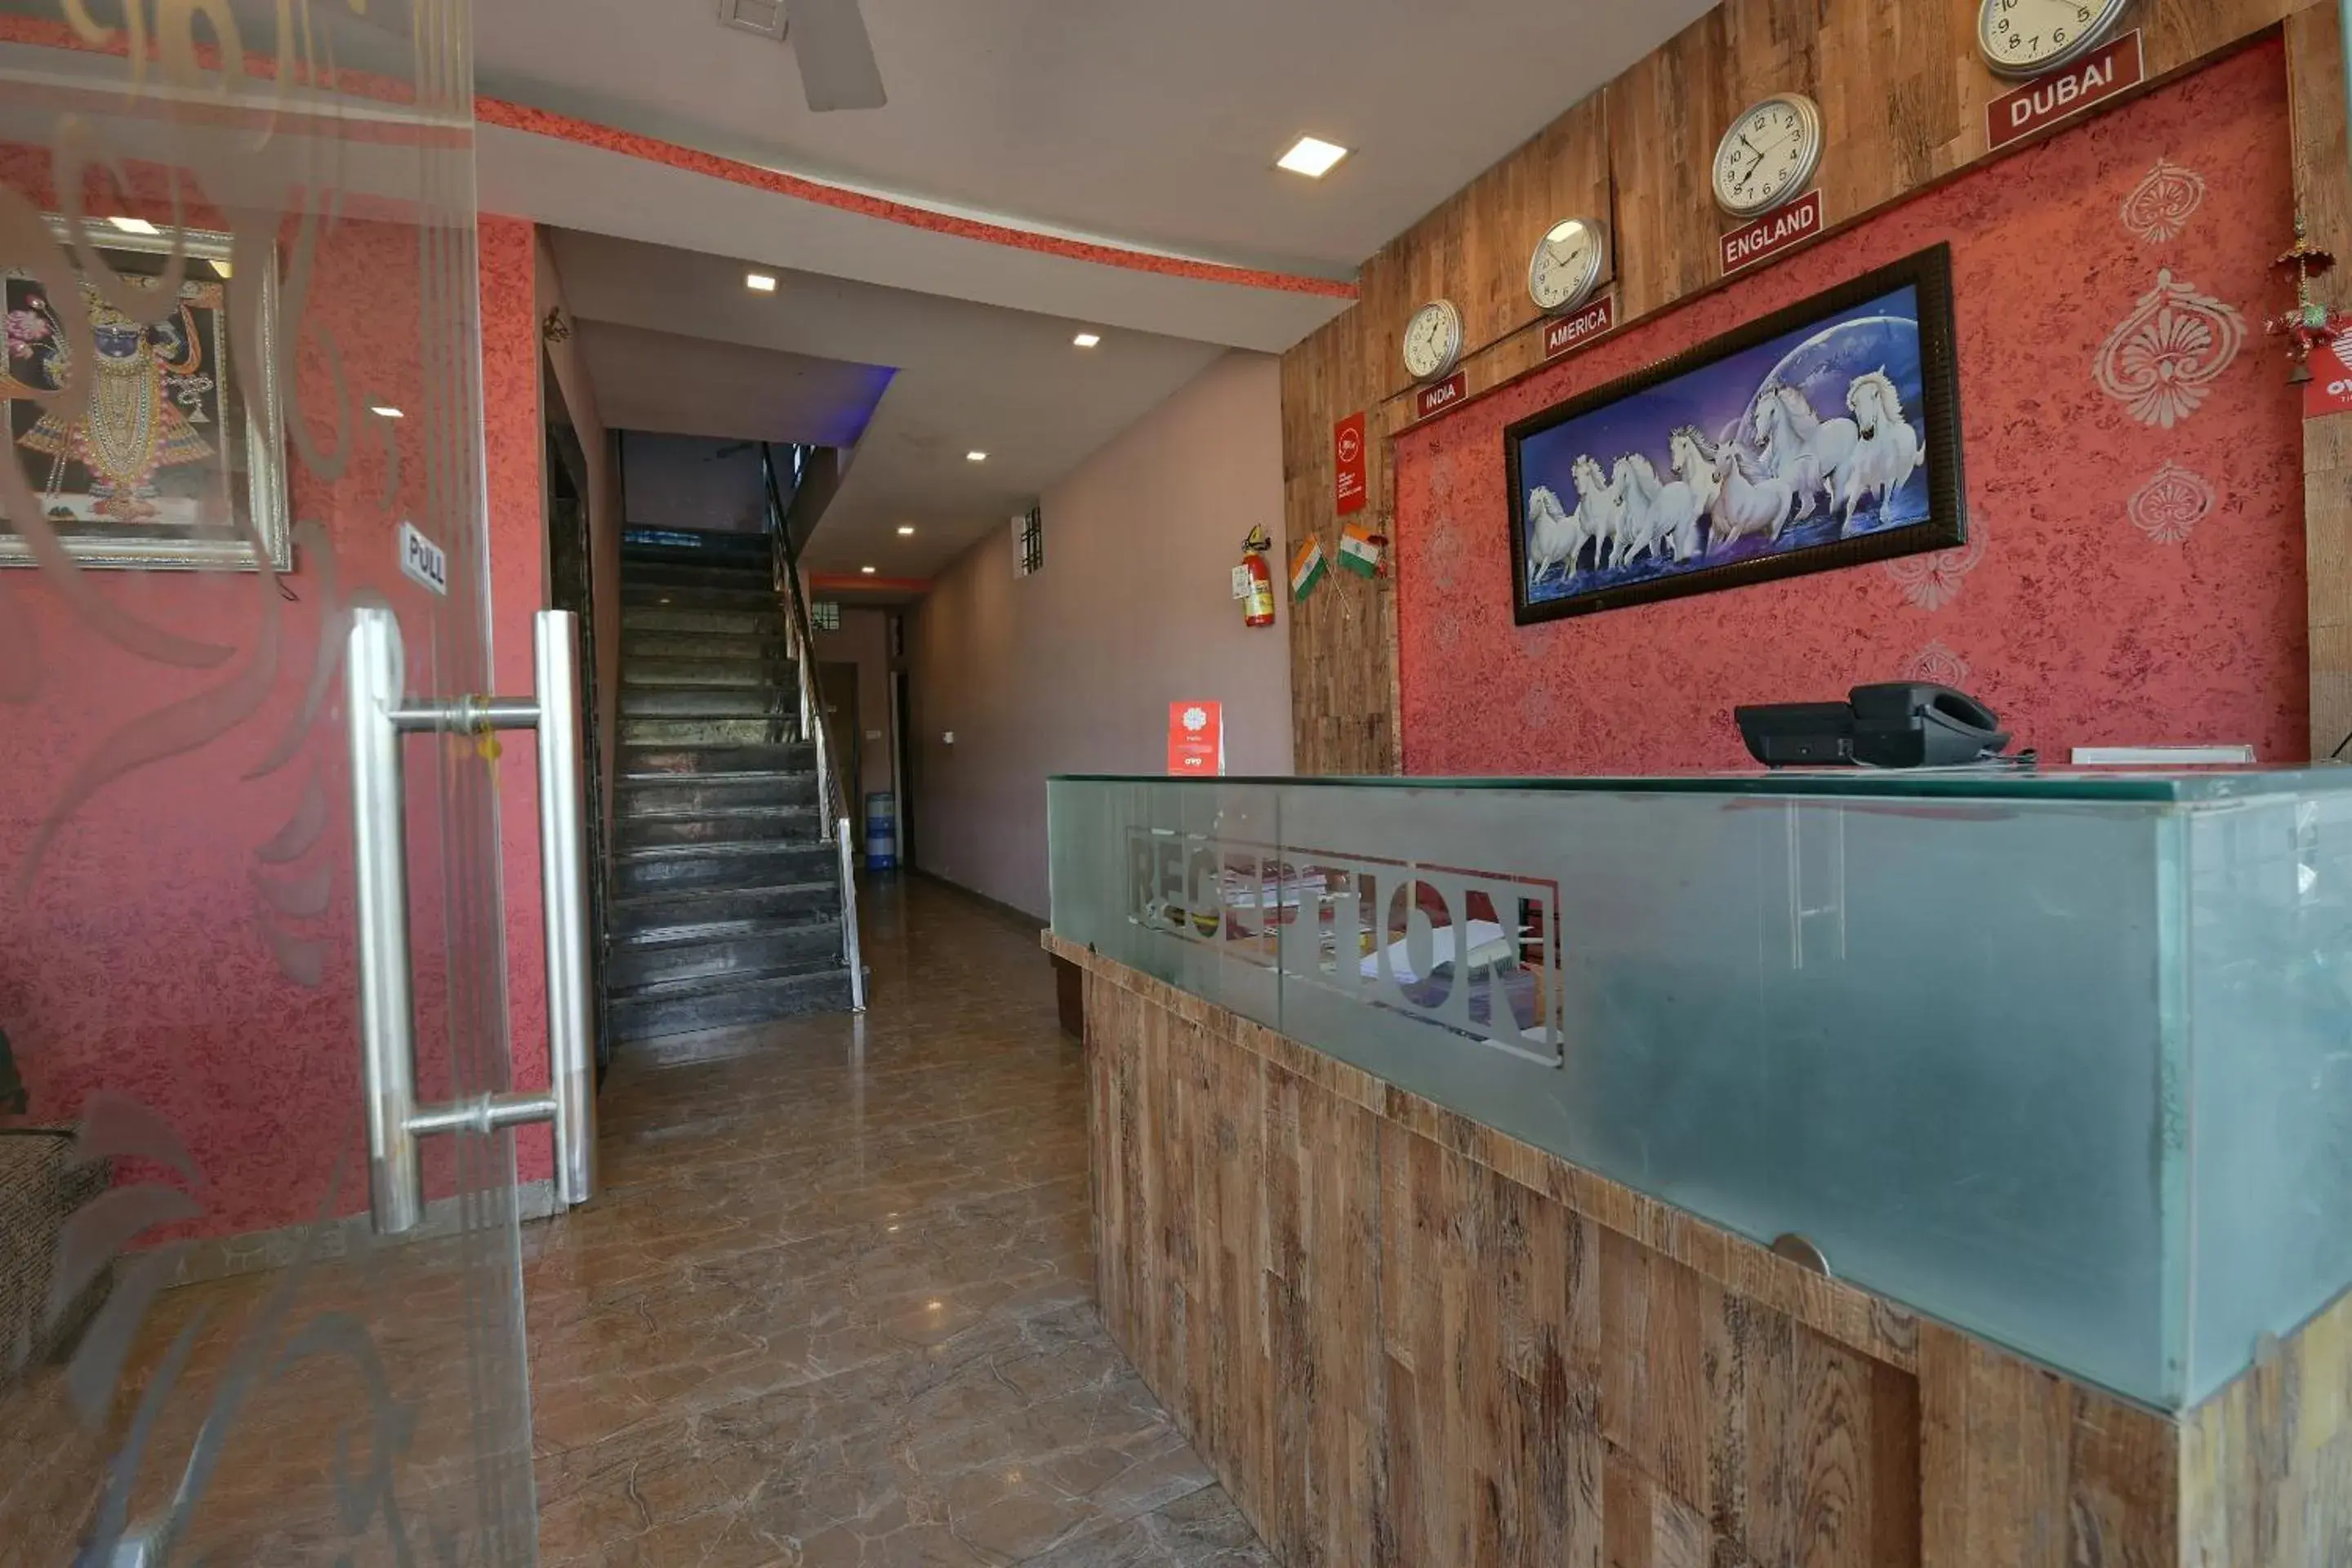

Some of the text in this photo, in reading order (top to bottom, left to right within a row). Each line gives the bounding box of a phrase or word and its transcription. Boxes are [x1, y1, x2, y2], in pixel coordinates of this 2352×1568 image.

[2077, 6, 2091, 23] 5
[1998, 18, 2010, 33] 9
[2008, 33, 2021, 50] 8
[2028, 35, 2040, 51] 7
[2052, 28, 2066, 43] 6
[2011, 56, 2114, 127] DUBAI
[1753, 117, 1766, 131] 12
[1784, 115, 1795, 129] 2
[1792, 129, 1802, 142] 3
[1730, 150, 1741, 165] 10
[1789, 148, 1797, 160] 4
[1727, 170, 1735, 182] 9
[1779, 167, 1787, 181] 5
[1734, 183, 1743, 196] 8
[1747, 188, 1754, 199] 7
[1762, 183, 1771, 195] 6
[1726, 204, 1814, 263] ENGLAND
[1549, 308, 1607, 350] AMERICA
[1426, 383, 1456, 410] INDIA
[409, 532, 444, 586] PULL
[1130, 837, 1548, 1044] RECEPTION
